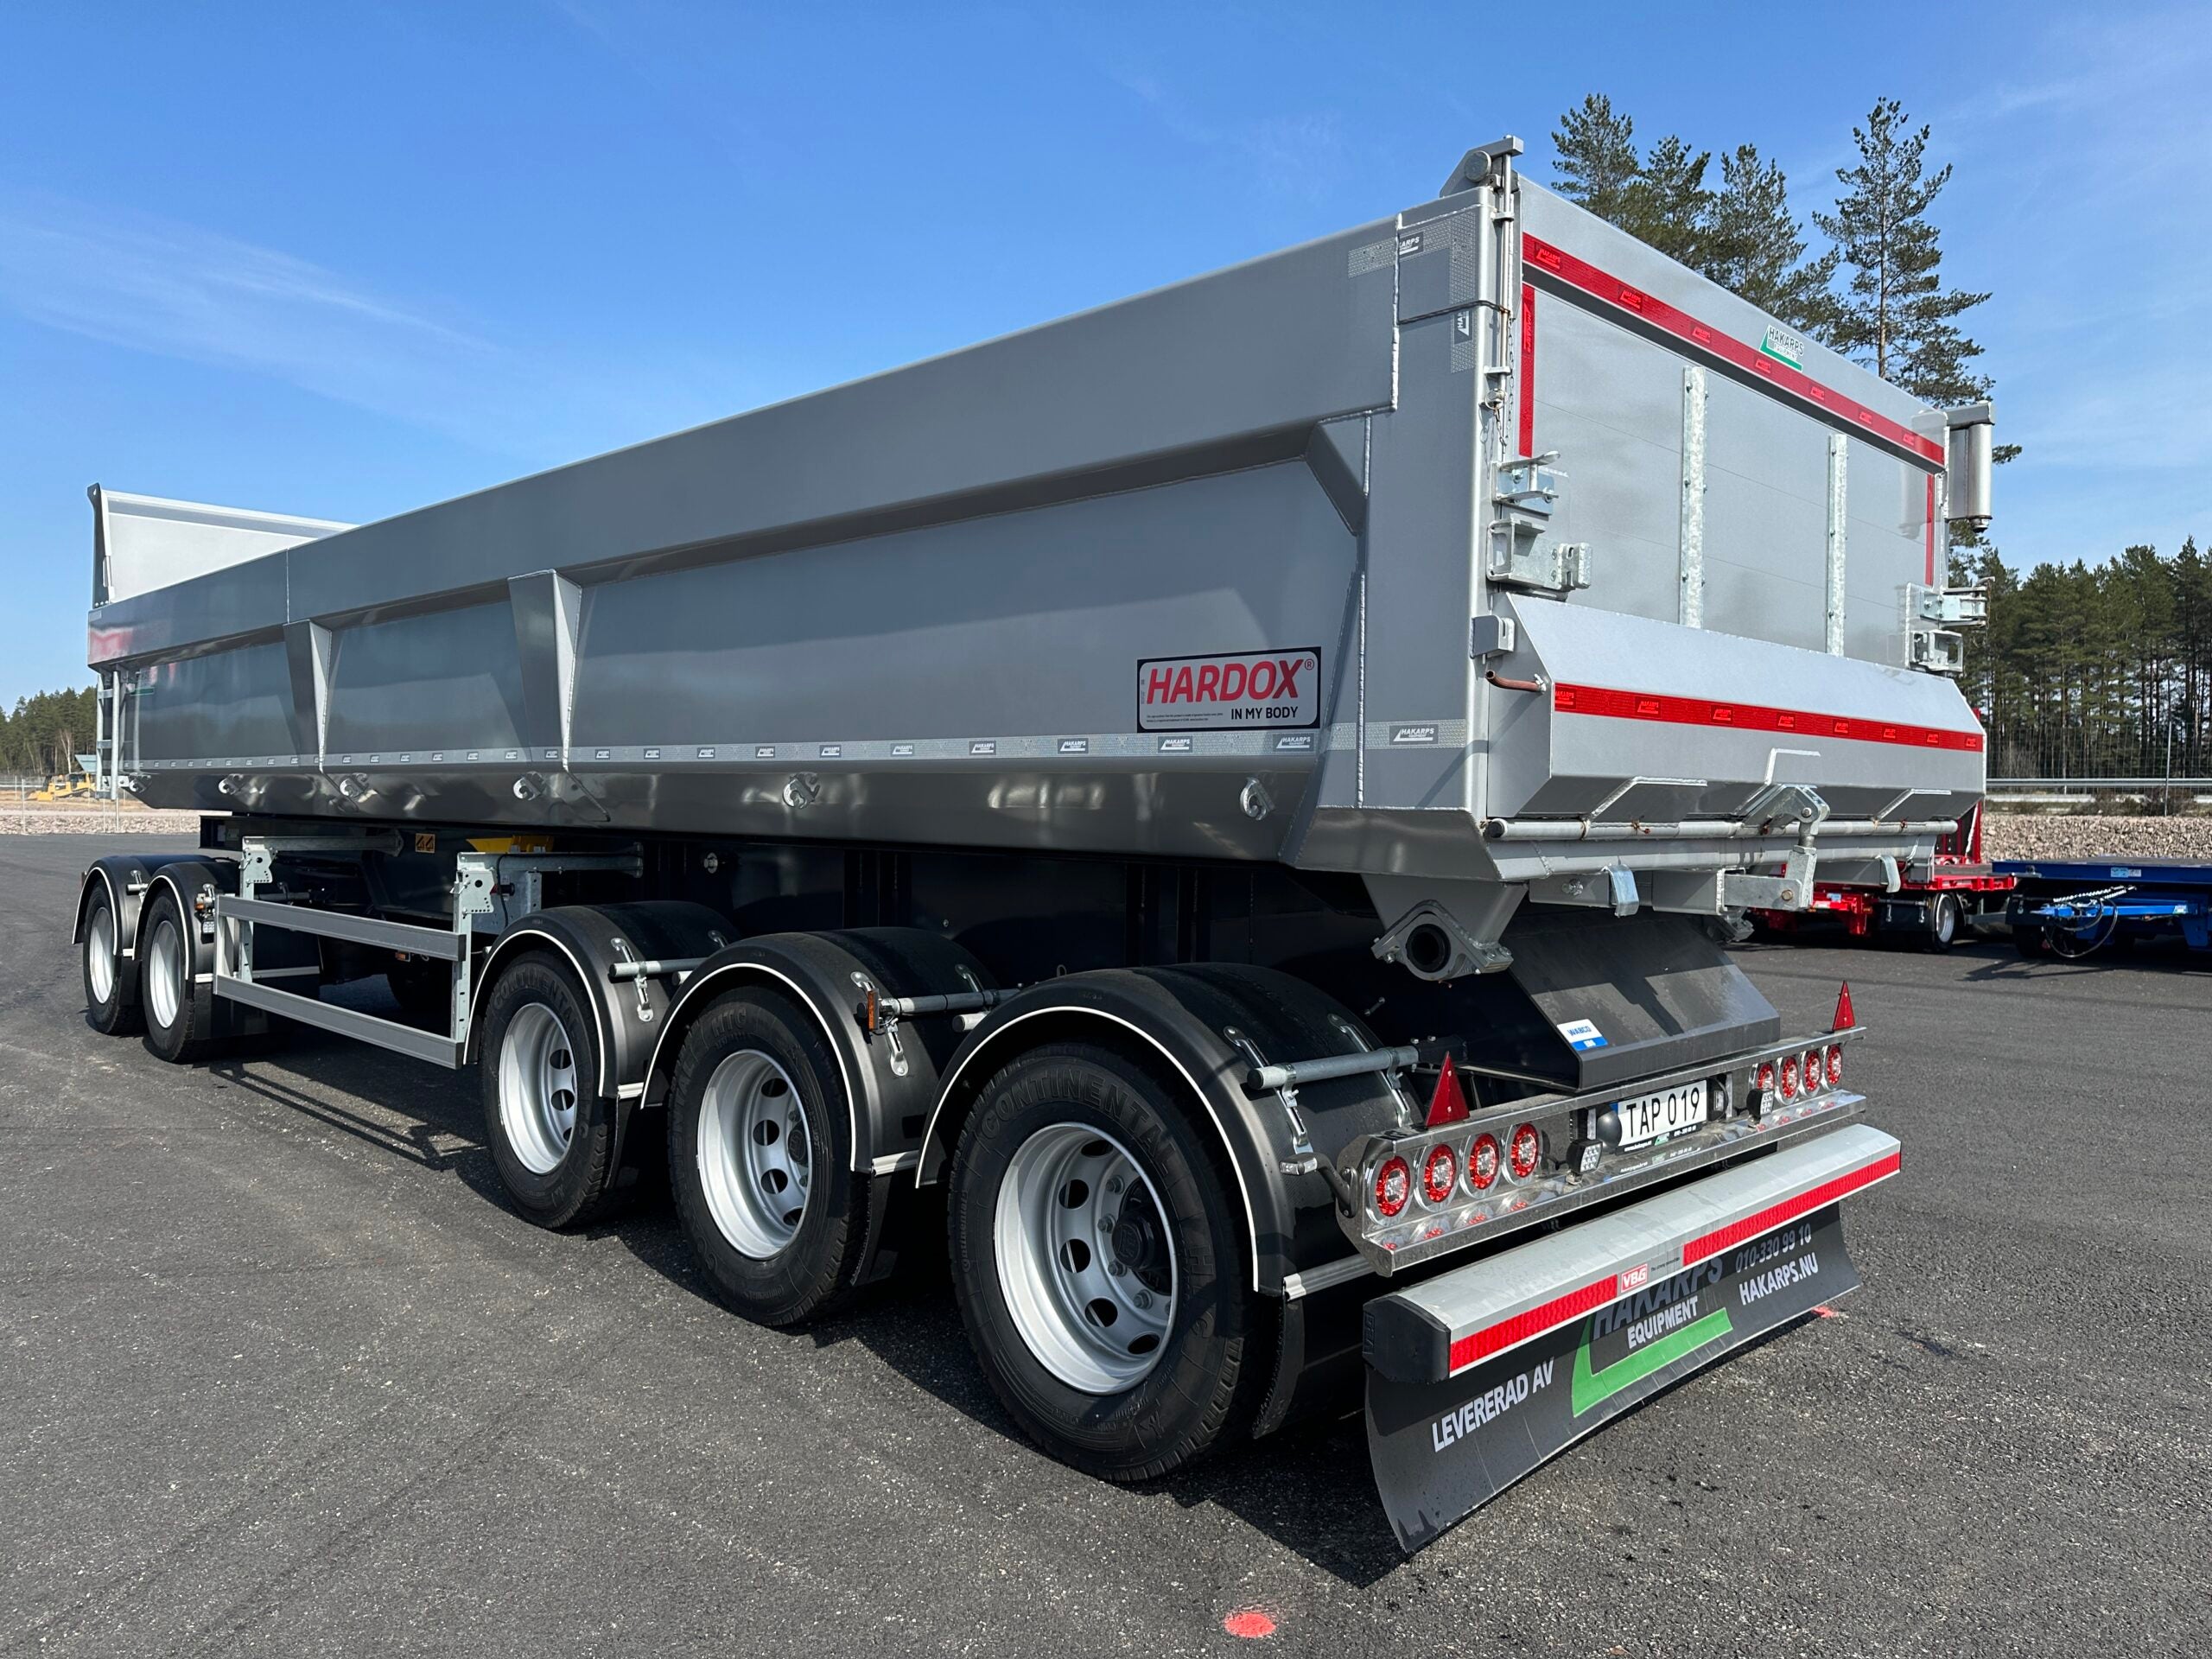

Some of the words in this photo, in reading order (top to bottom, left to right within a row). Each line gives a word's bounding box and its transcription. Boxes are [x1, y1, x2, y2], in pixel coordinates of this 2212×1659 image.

[1768, 326, 1804, 356] HAKARPS
[1230, 708, 1243, 721] IN
[1245, 707, 1263, 720] MY
[1265, 706, 1299, 719] BODY
[981, 1068, 1177, 1175] CONTINENTAL
[1625, 1096, 1661, 1138] TAP
[1668, 1087, 1700, 1126] 019
[1735, 1236, 1780, 1274] 010-330
[1782, 1230, 1796, 1254] 99
[1798, 1223, 1812, 1246] 10
[1623, 1267, 1647, 1288] VBG
[1738, 1251, 1819, 1306] HAKARPS.NU
[1627, 1295, 1699, 1350] EQUIPMENT
[1431, 1372, 1529, 1453] LEVERERAD
[1531, 1356, 1555, 1395] AV
